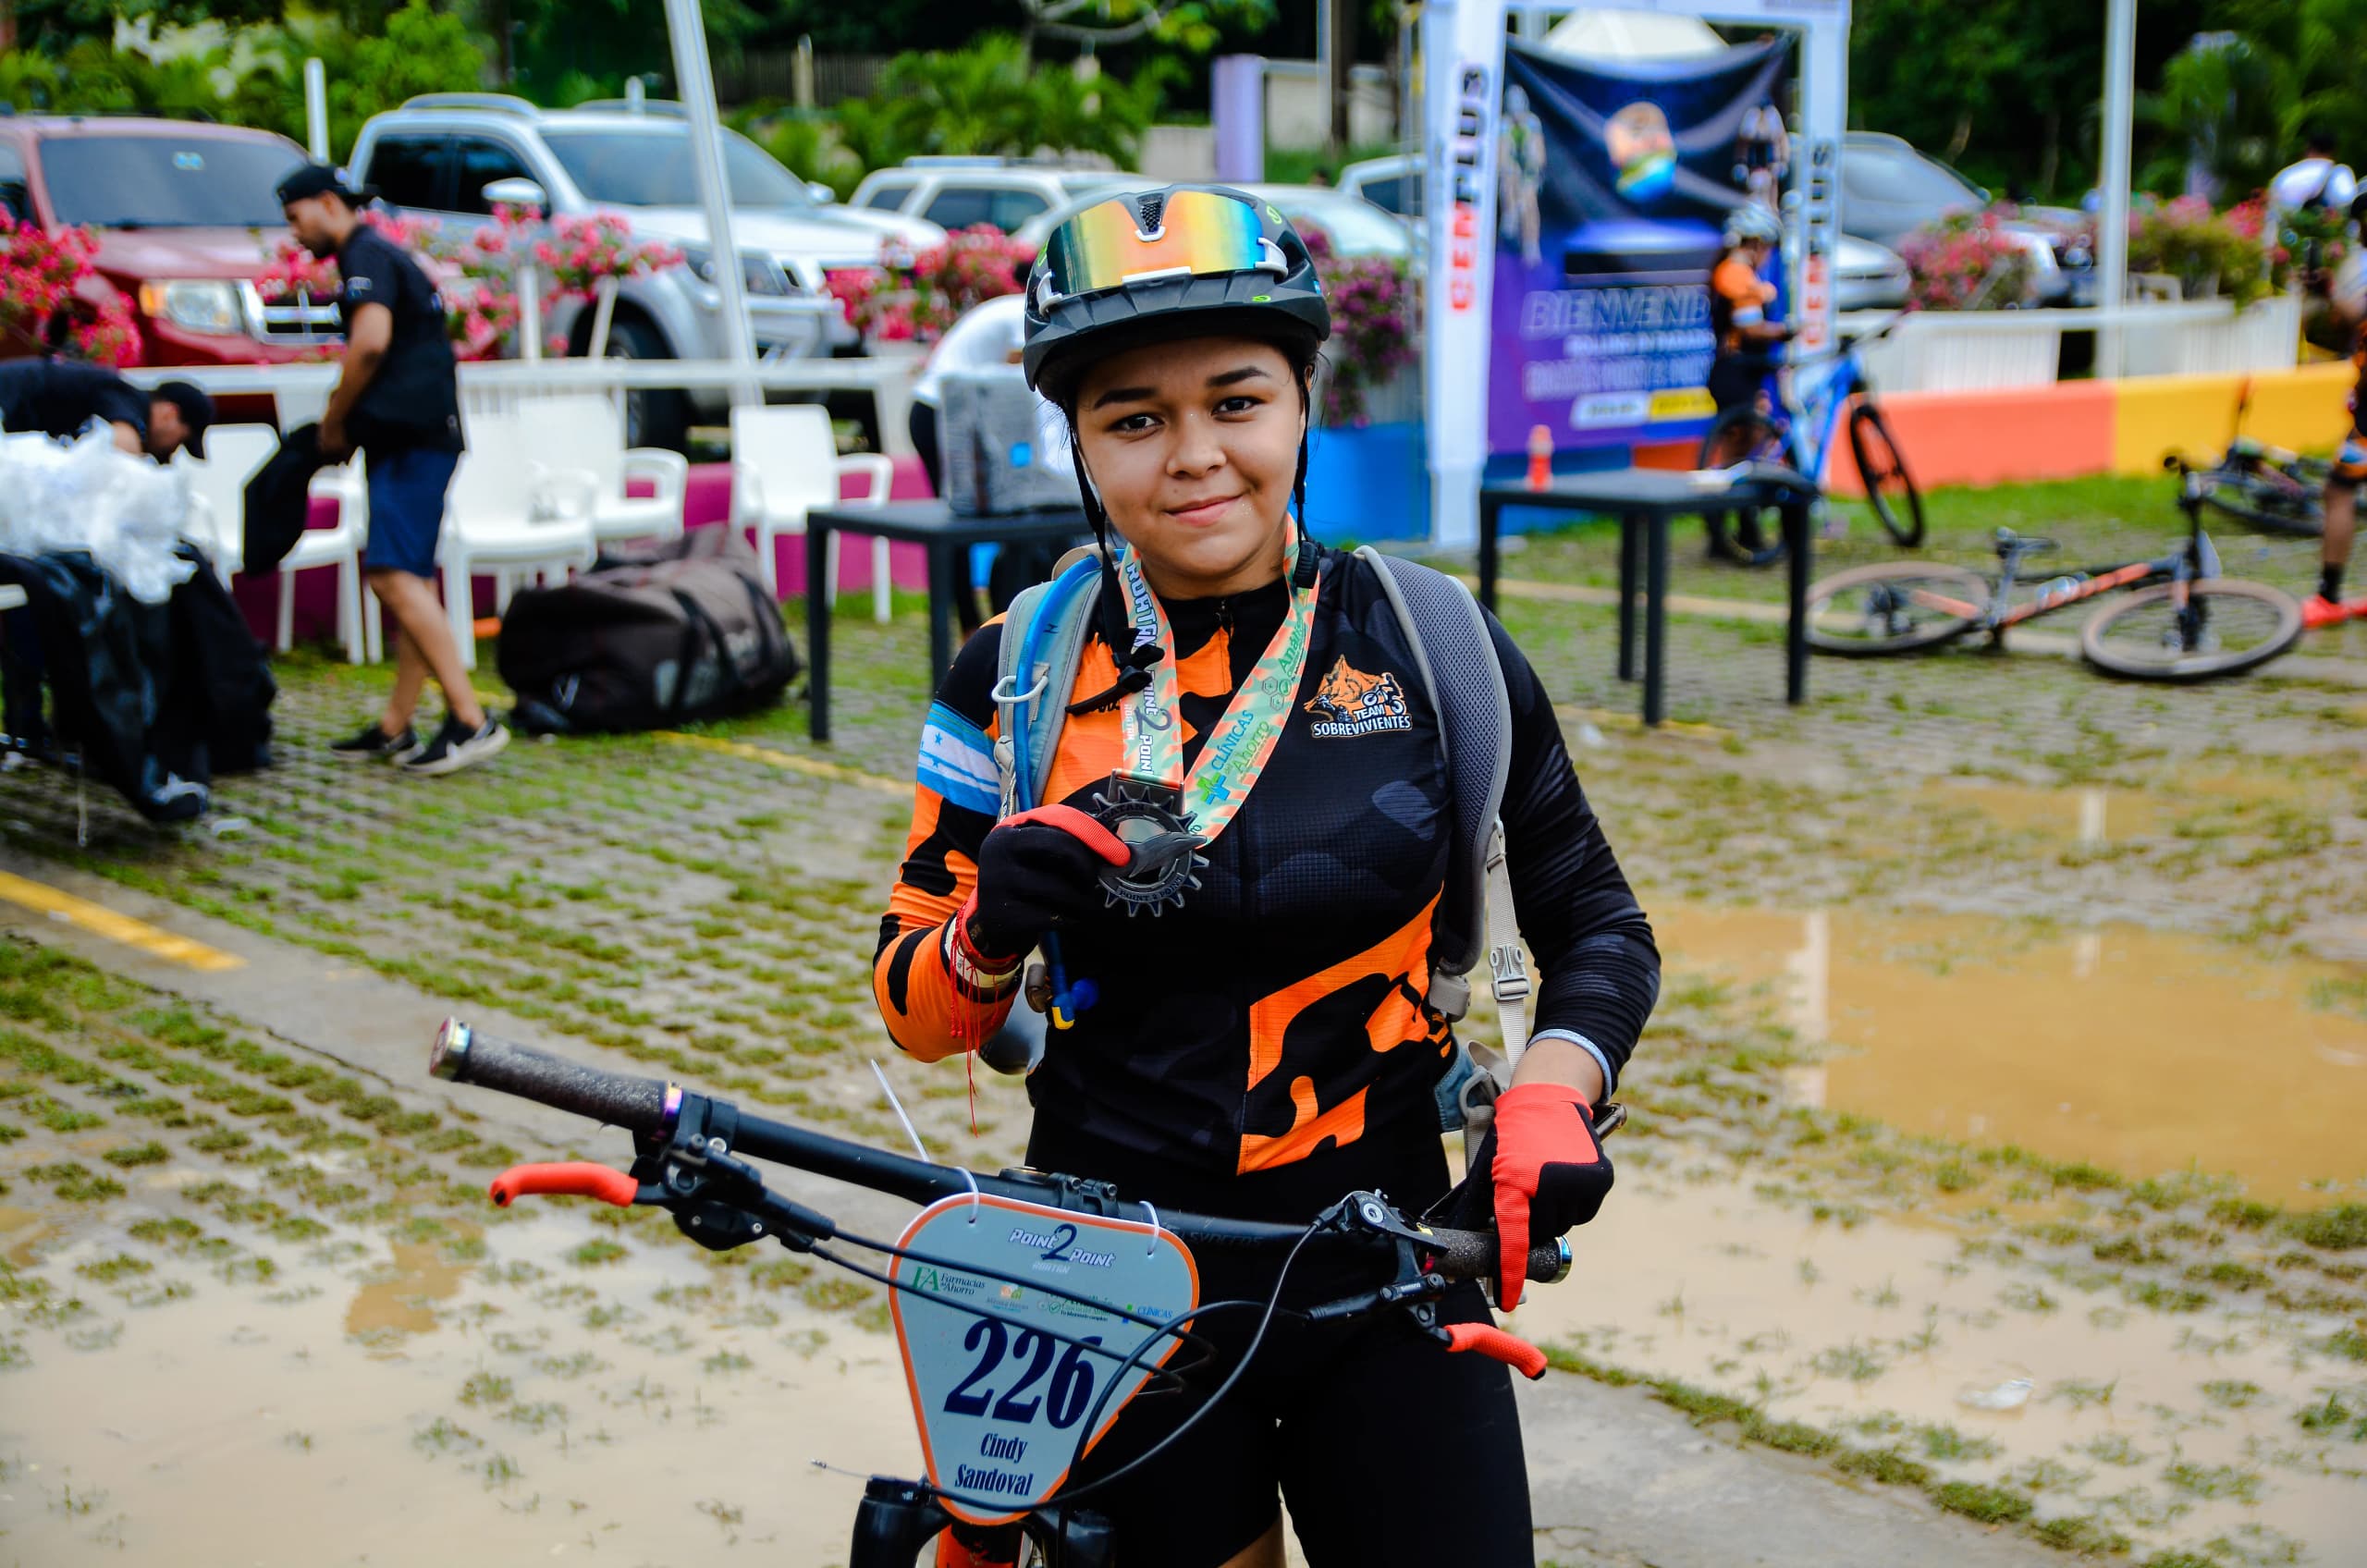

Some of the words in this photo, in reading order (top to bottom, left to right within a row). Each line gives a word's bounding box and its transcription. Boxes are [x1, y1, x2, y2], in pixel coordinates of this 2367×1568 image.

[1134, 705, 1172, 735] 2
[1313, 716, 1411, 736] SOBREVIVIENTES
[1353, 704, 1385, 721] TEAM
[1210, 709, 1255, 771] CLÍNICAS
[1232, 720, 1269, 774] Ahorro
[1101, 803, 1146, 821] OATAN
[1040, 1223, 1077, 1260] 2
[941, 1272, 986, 1289] Farmacias
[943, 1317, 1103, 1429] 226
[980, 1432, 1029, 1464] Cindy
[953, 1464, 1035, 1497] Sandoval
